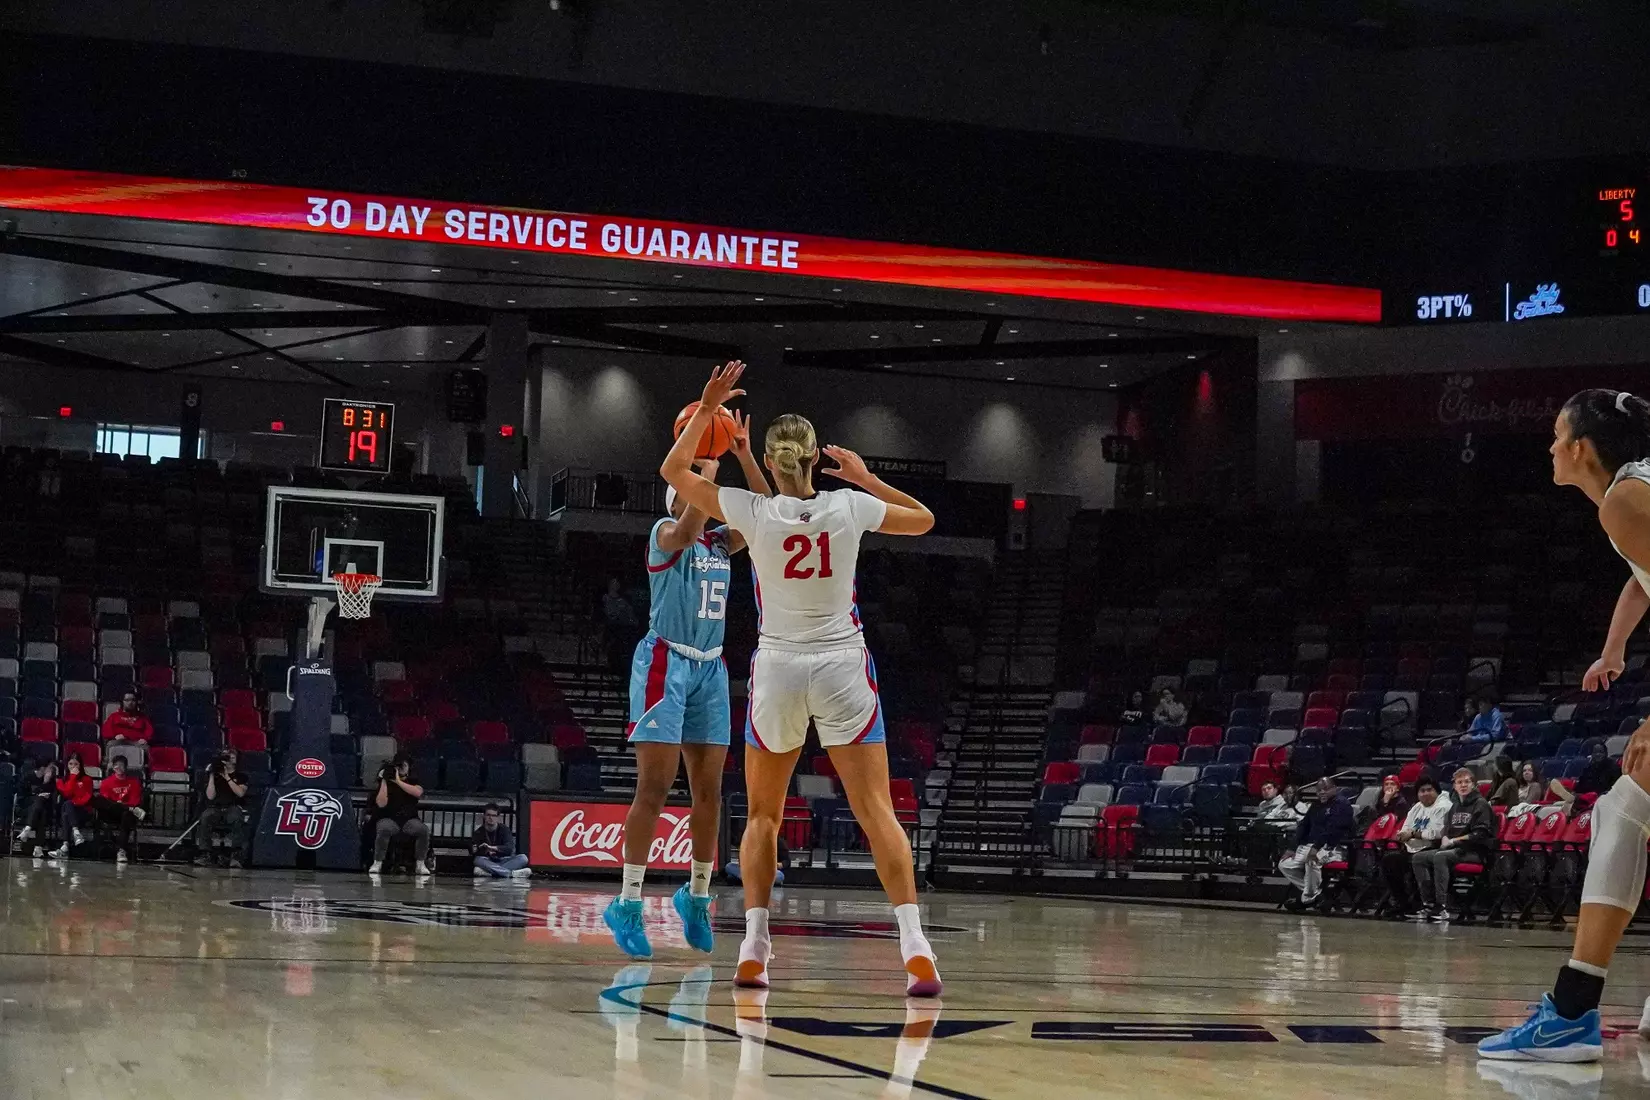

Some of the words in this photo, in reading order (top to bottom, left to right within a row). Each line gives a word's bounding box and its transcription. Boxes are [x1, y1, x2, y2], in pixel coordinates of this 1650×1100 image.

[1599, 188, 1636, 200] LIBERTY
[1620, 201, 1633, 221] 5
[307, 198, 350, 228] 30
[366, 203, 430, 234] DAY
[445, 210, 587, 249] SERVICE
[602, 224, 798, 268] GUARANTEE
[1607, 230, 1617, 246] 0
[1630, 230, 1640, 243] 4
[1417, 294, 1472, 319] 3PT%
[349, 430, 377, 462] 19
[783, 532, 831, 579] 21
[698, 579, 727, 620] 15
